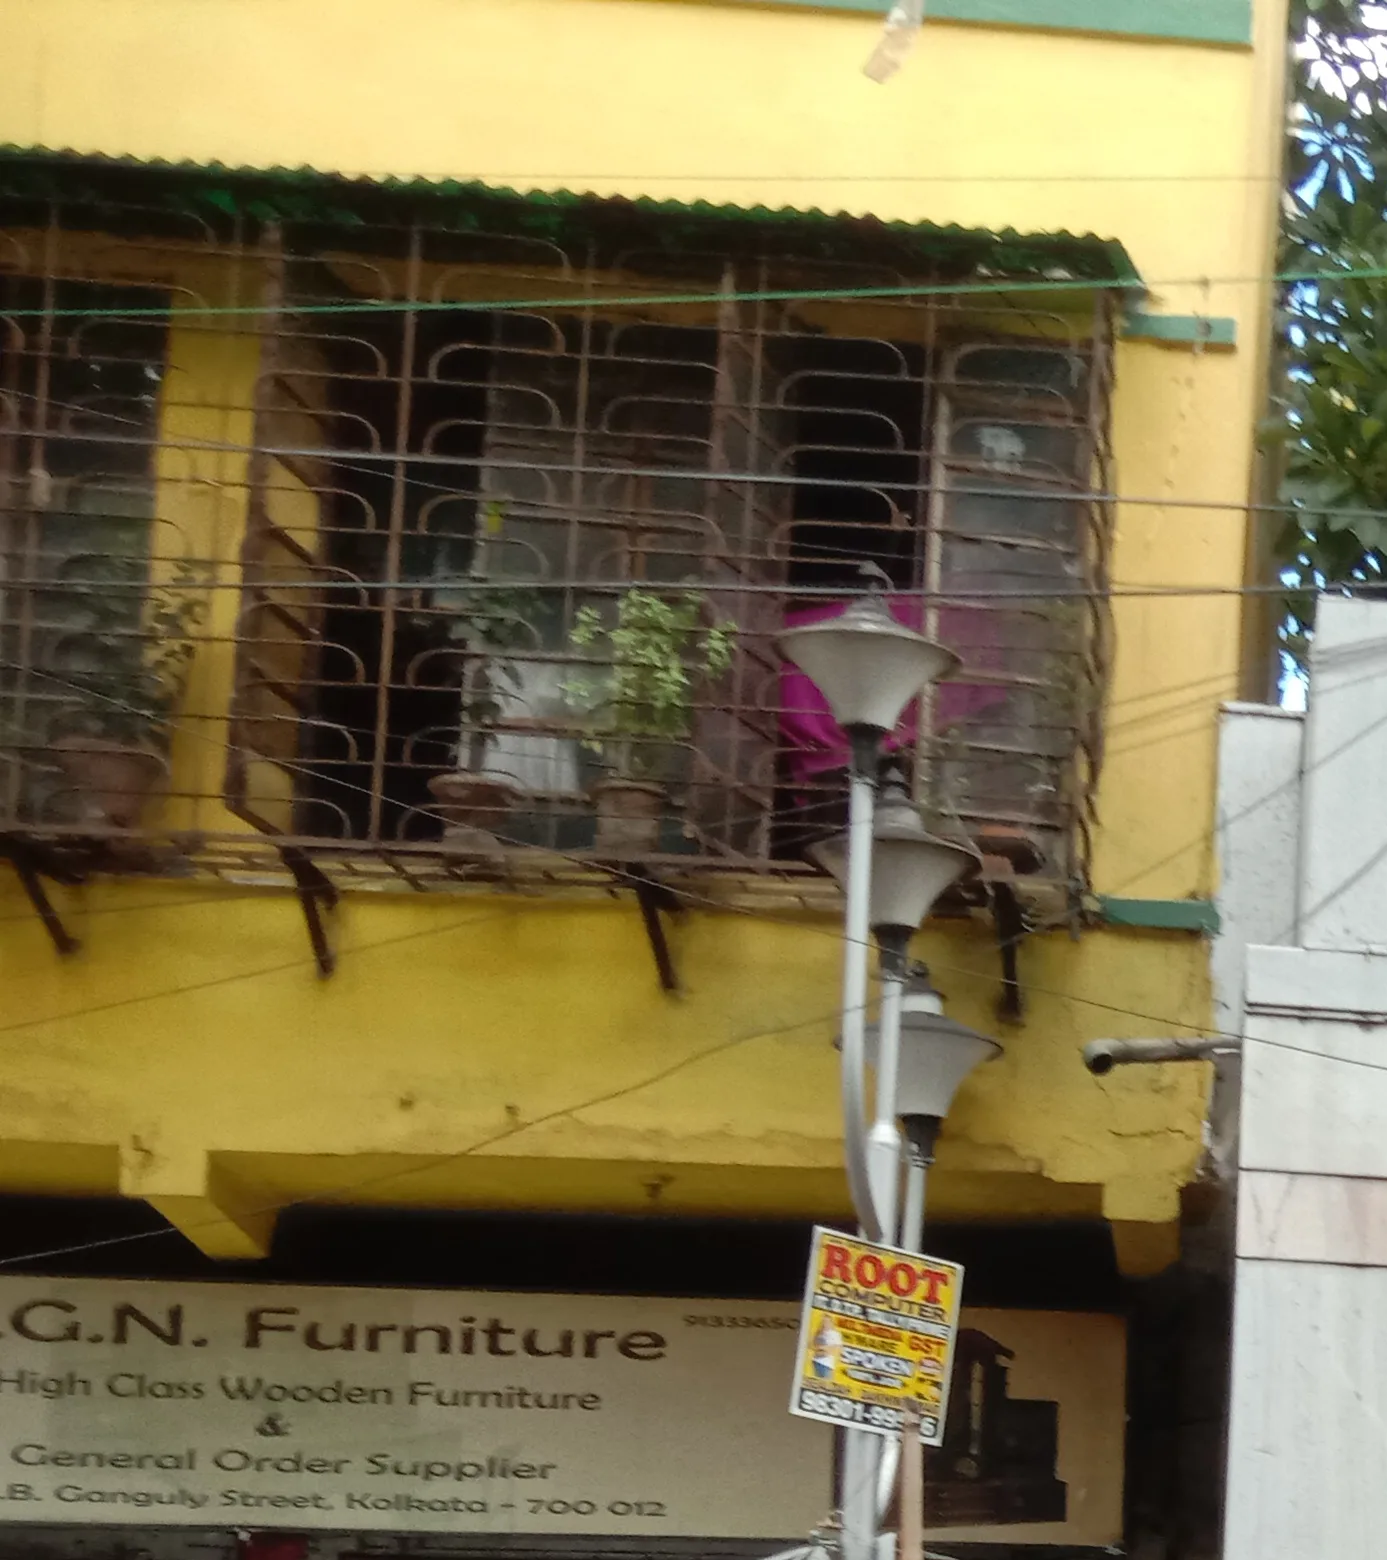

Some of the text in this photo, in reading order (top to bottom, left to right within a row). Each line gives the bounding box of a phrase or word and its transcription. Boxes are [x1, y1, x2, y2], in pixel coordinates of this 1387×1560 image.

[821, 1243, 948, 1305] ROOT
[818, 1279, 947, 1322] COMPUTER
[245, 1306, 668, 1361] Furniture
[0, 1369, 603, 1411] High Class Wooden Furniture
[255, 1413, 292, 1437] &
[10, 1443, 558, 1482] General Order Supplier
[53, 1484, 210, 1510] Ganguly
[346, 1492, 488, 1514] Kolkata
[525, 1498, 599, 1516] 700
[606, 1500, 668, 1518] 012
